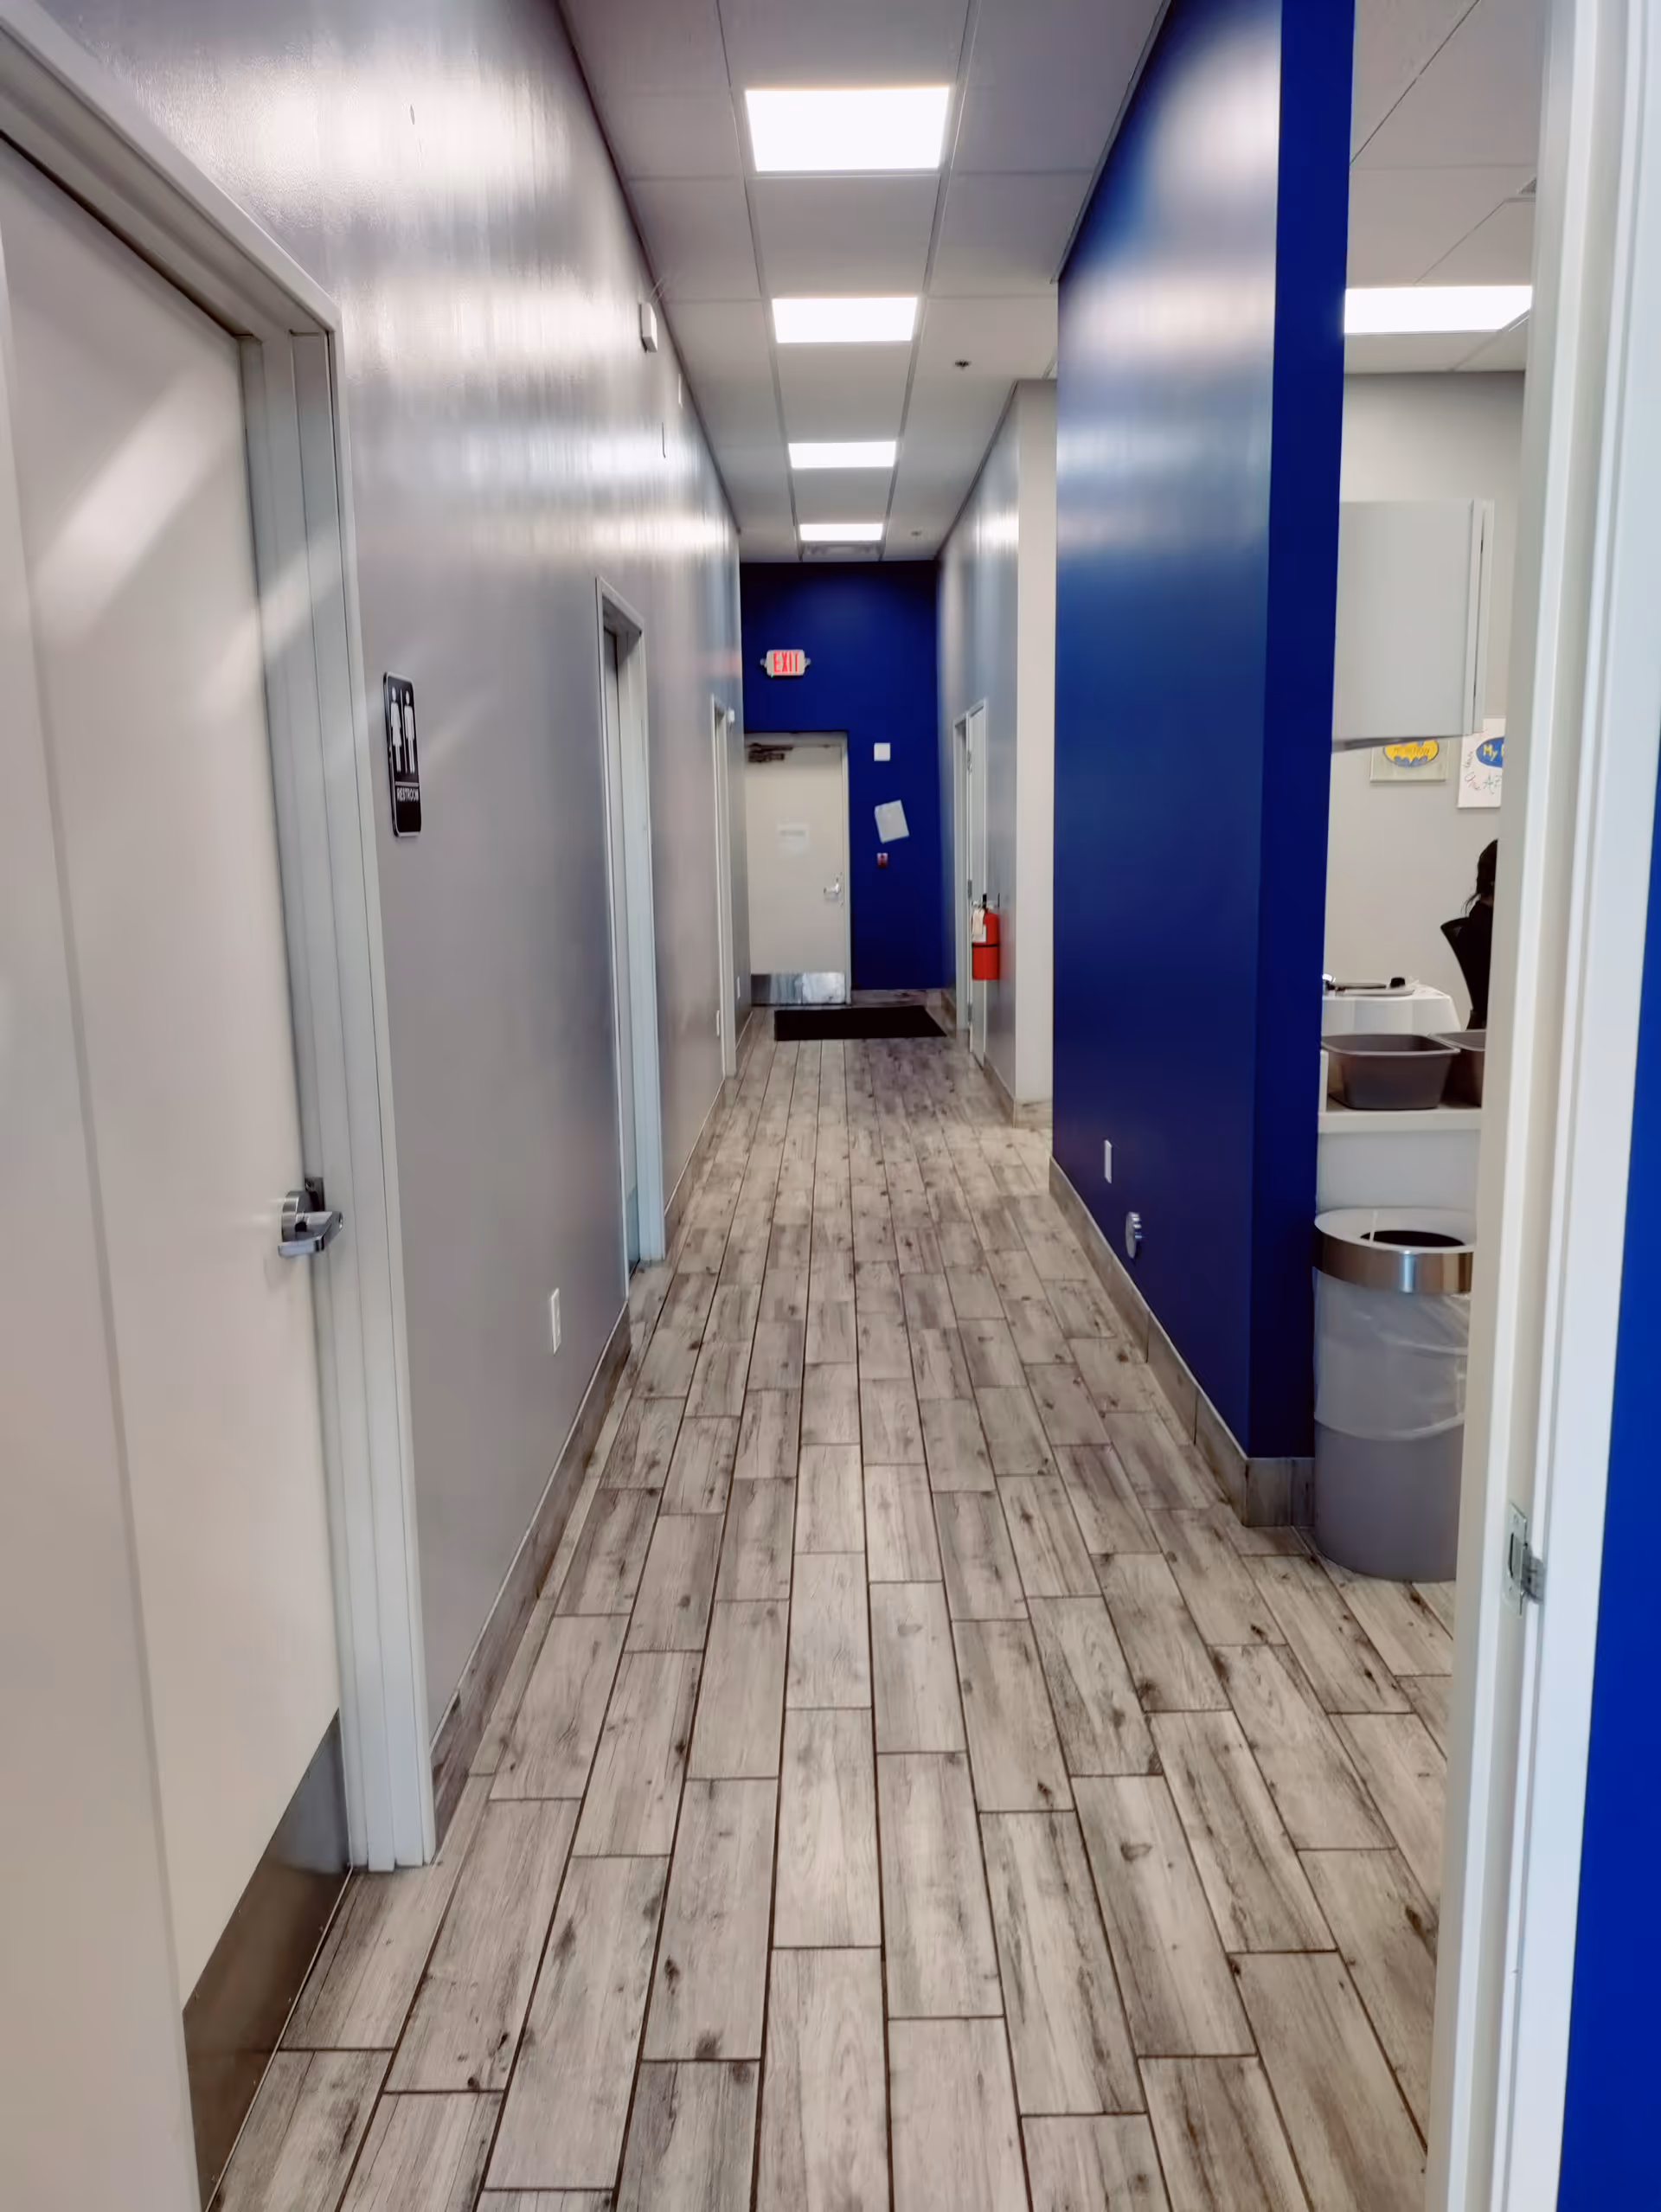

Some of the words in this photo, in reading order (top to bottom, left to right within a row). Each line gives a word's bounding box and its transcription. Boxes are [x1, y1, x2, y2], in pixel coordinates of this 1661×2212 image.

[773, 651, 799, 674] EXIT
[1483, 744, 1498, 762] My
[396, 787, 420, 802] RESTROOM
